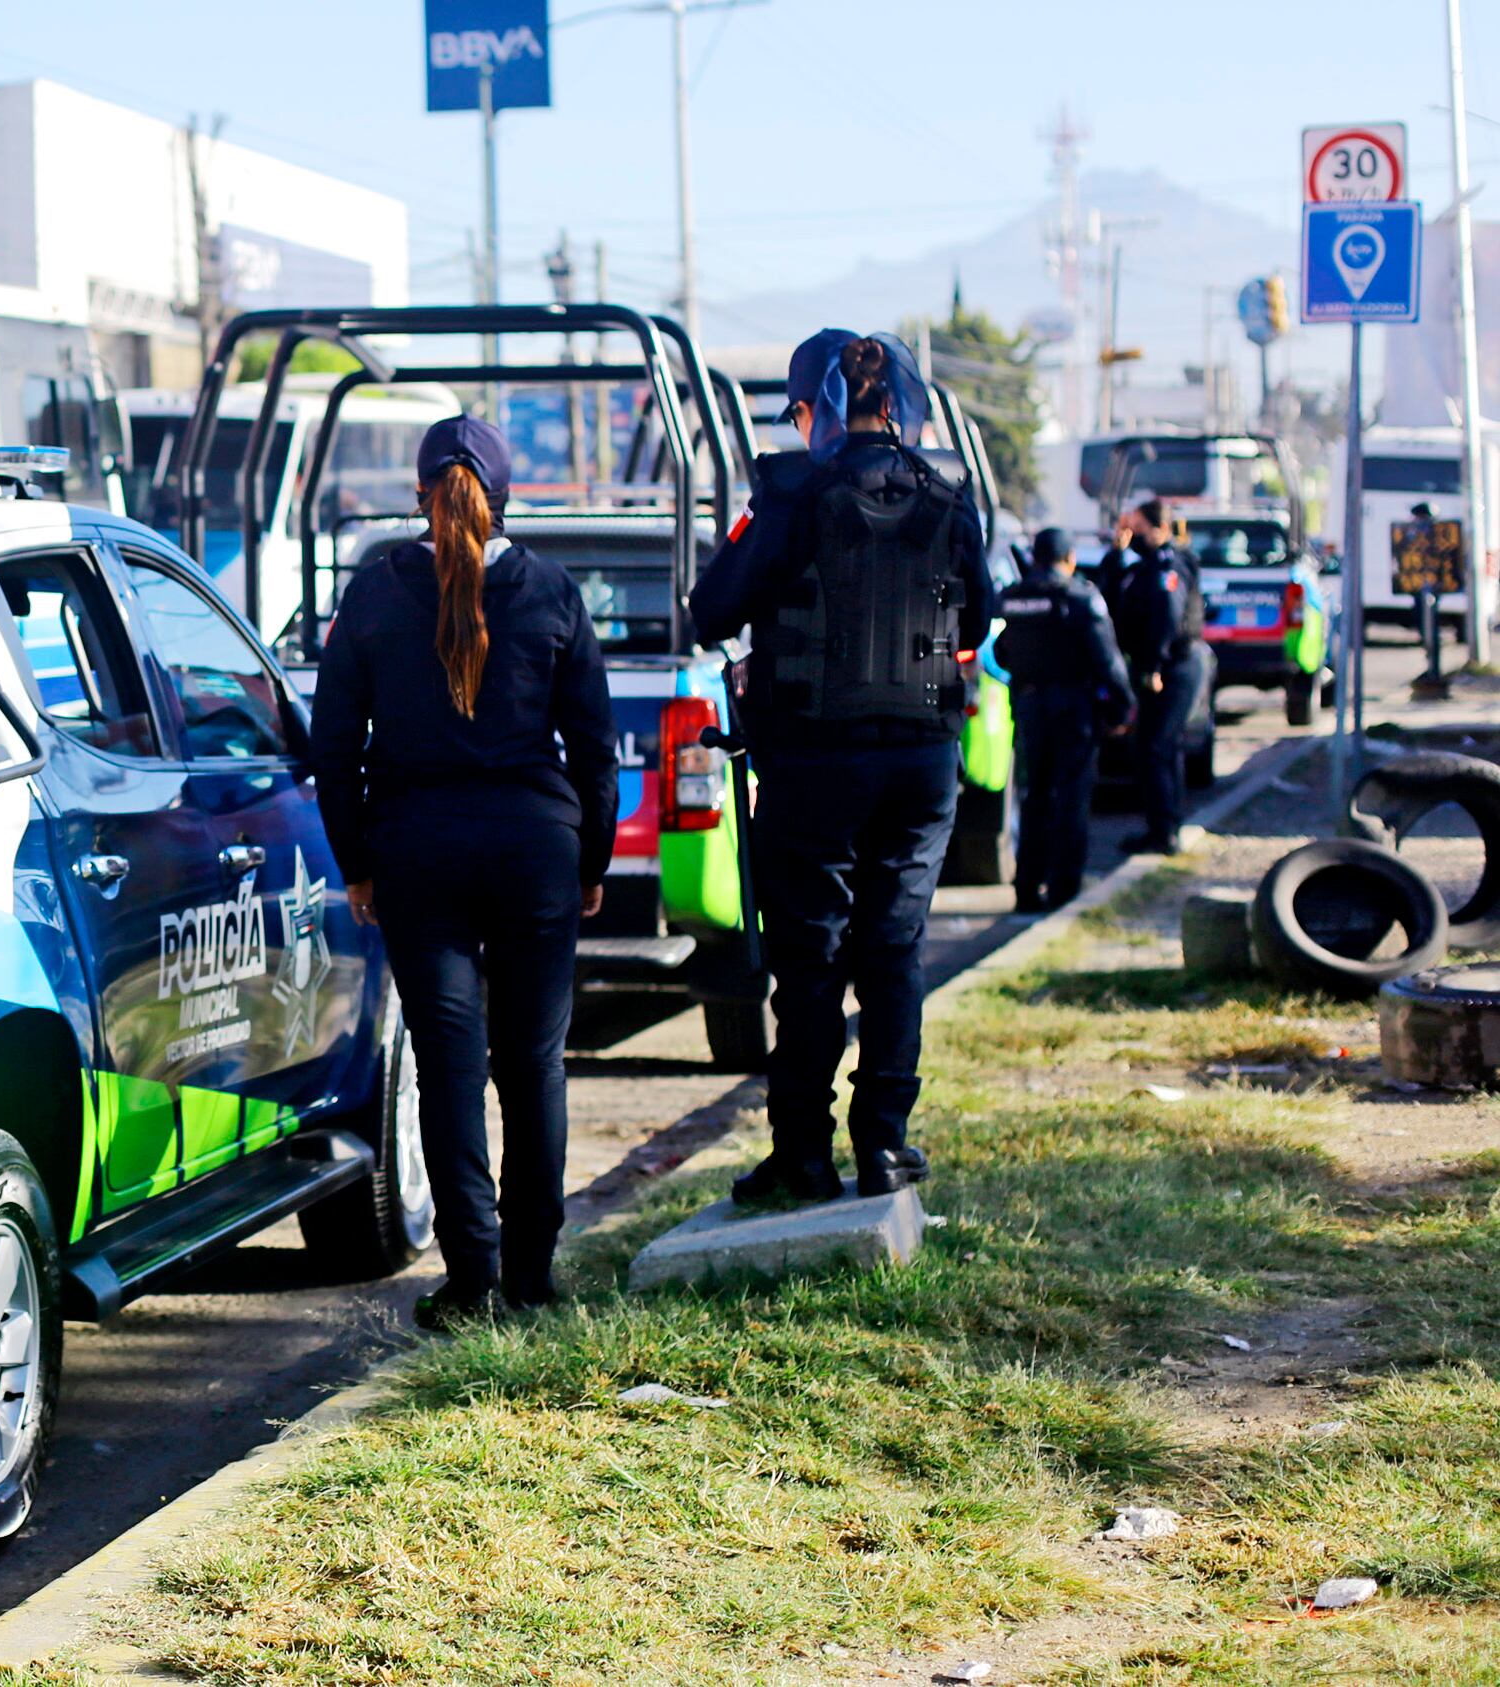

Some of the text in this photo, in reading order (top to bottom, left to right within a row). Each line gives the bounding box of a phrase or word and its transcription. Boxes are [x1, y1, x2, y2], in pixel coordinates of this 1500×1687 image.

[430, 26, 544, 68] BBVA
[1333, 147, 1378, 180] 30
[157, 868, 267, 1000] POLICÍA
[179, 985, 240, 1030] MUNICIPAL
